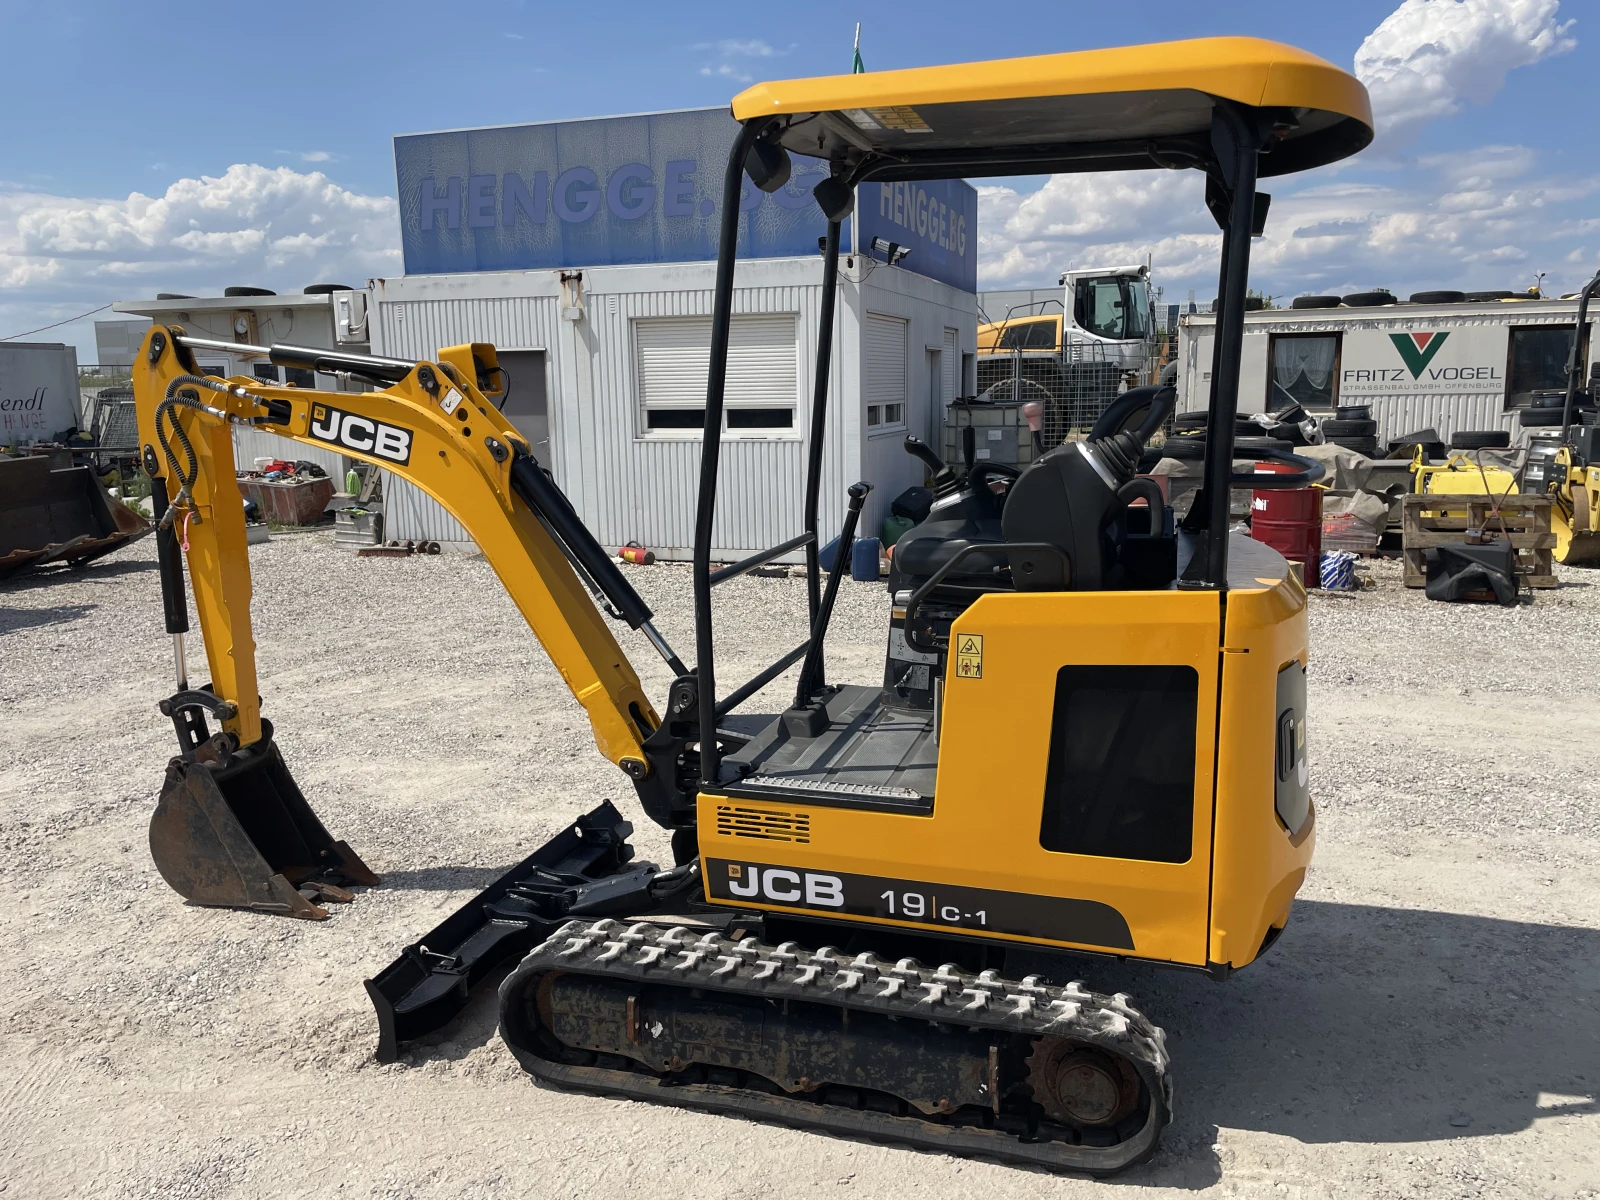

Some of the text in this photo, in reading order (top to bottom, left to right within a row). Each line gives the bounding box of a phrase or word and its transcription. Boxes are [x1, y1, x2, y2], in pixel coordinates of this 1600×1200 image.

[880, 181, 966, 257] HENGGE.BG
[1344, 367, 1502, 382] FRITZ VOGEL
[312, 410, 410, 461] JCB
[729, 866, 845, 907] JCB
